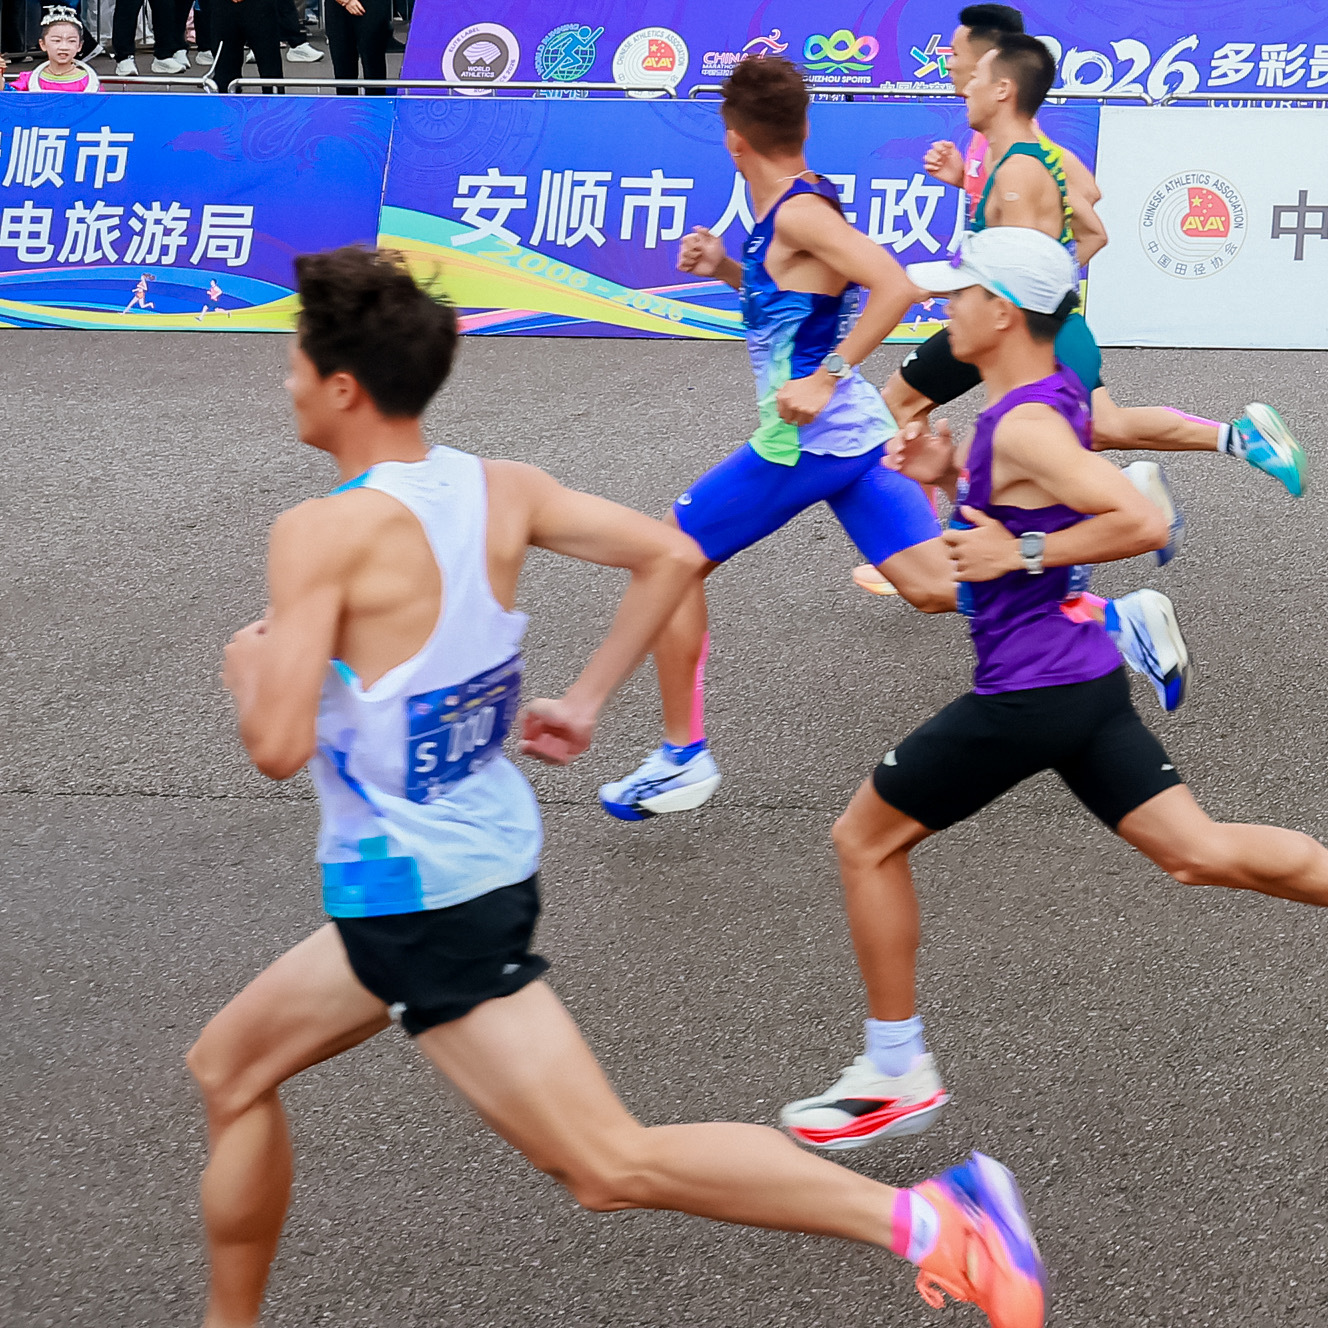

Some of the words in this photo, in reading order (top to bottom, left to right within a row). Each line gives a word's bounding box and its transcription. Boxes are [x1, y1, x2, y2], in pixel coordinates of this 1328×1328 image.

[1033, 34, 1201, 106] 026
[0, 125, 134, 190] 顺市
[1143, 190, 1167, 228] CHINESE
[1164, 174, 1212, 193] ATHLETICS
[1212, 177, 1244, 230] ASSOCIATION
